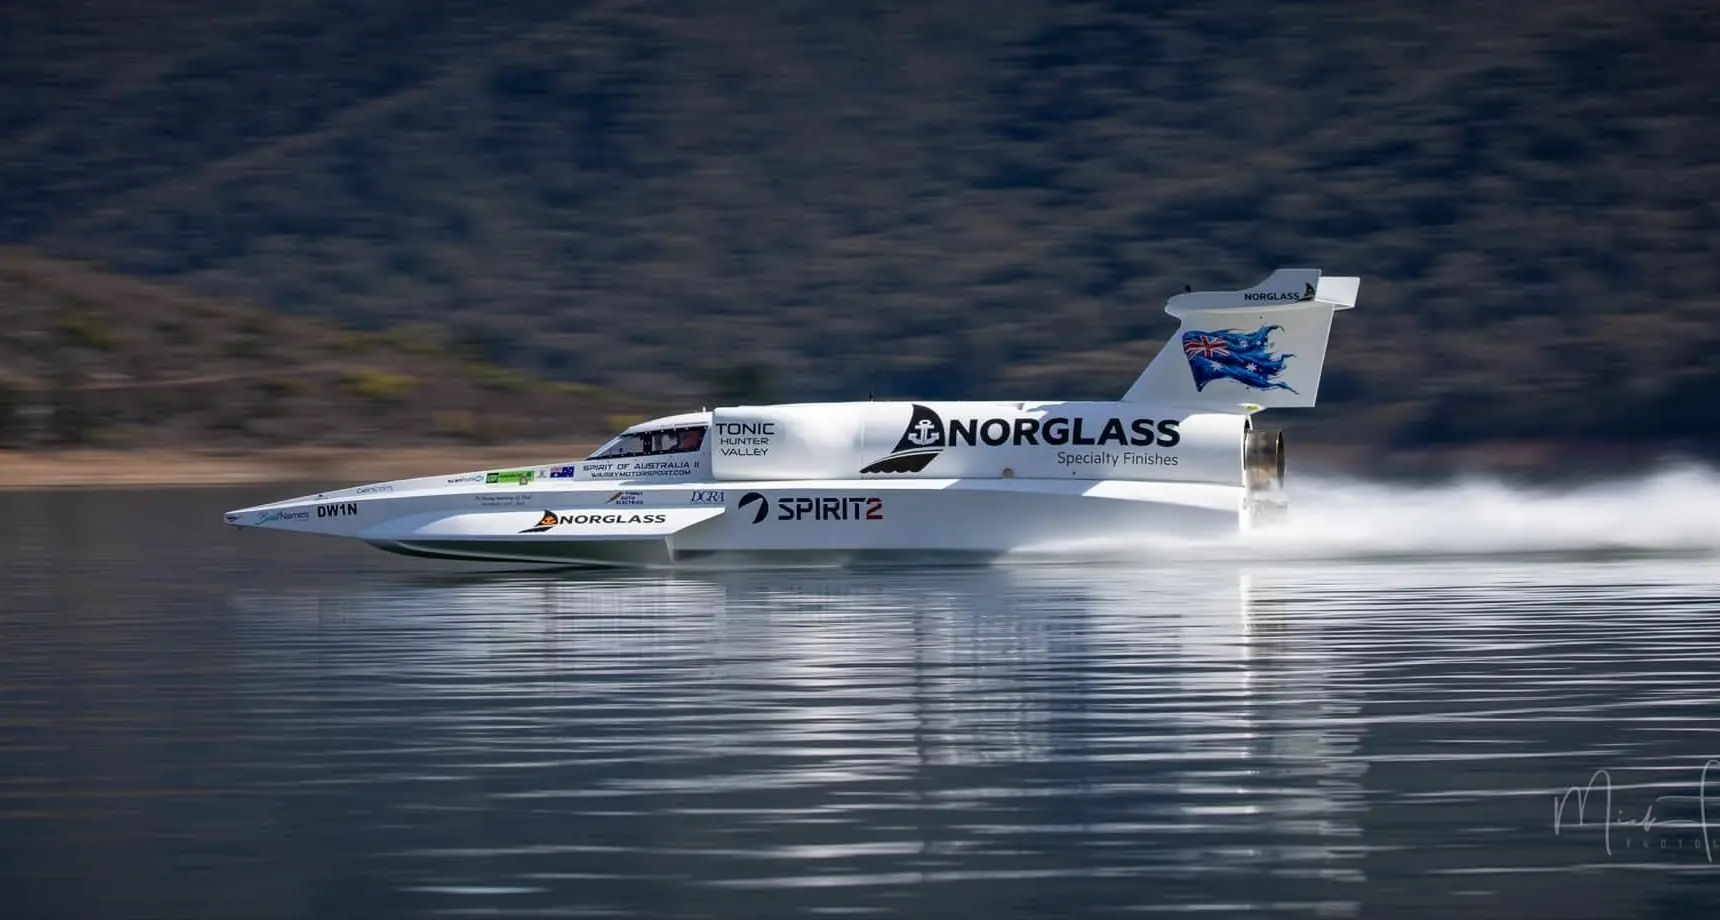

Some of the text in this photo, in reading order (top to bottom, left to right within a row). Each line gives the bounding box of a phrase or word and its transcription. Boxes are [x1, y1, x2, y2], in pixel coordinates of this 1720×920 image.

[1244, 292, 1300, 301] NORGLASS
[716, 423, 775, 435] TONIC
[948, 417, 1181, 447] NORGLASS
[720, 437, 769, 446] HUNTER
[721, 448, 769, 456] VALLEY
[1057, 452, 1179, 467] Specialty Finishes
[582, 463, 613, 472] SPIRIT
[634, 461, 690, 470] AUSTRALIA
[690, 490, 725, 502] DCRA
[317, 503, 358, 518] DW1N
[778, 497, 884, 521] SPIRIT2
[559, 514, 667, 524] NORGLASS
